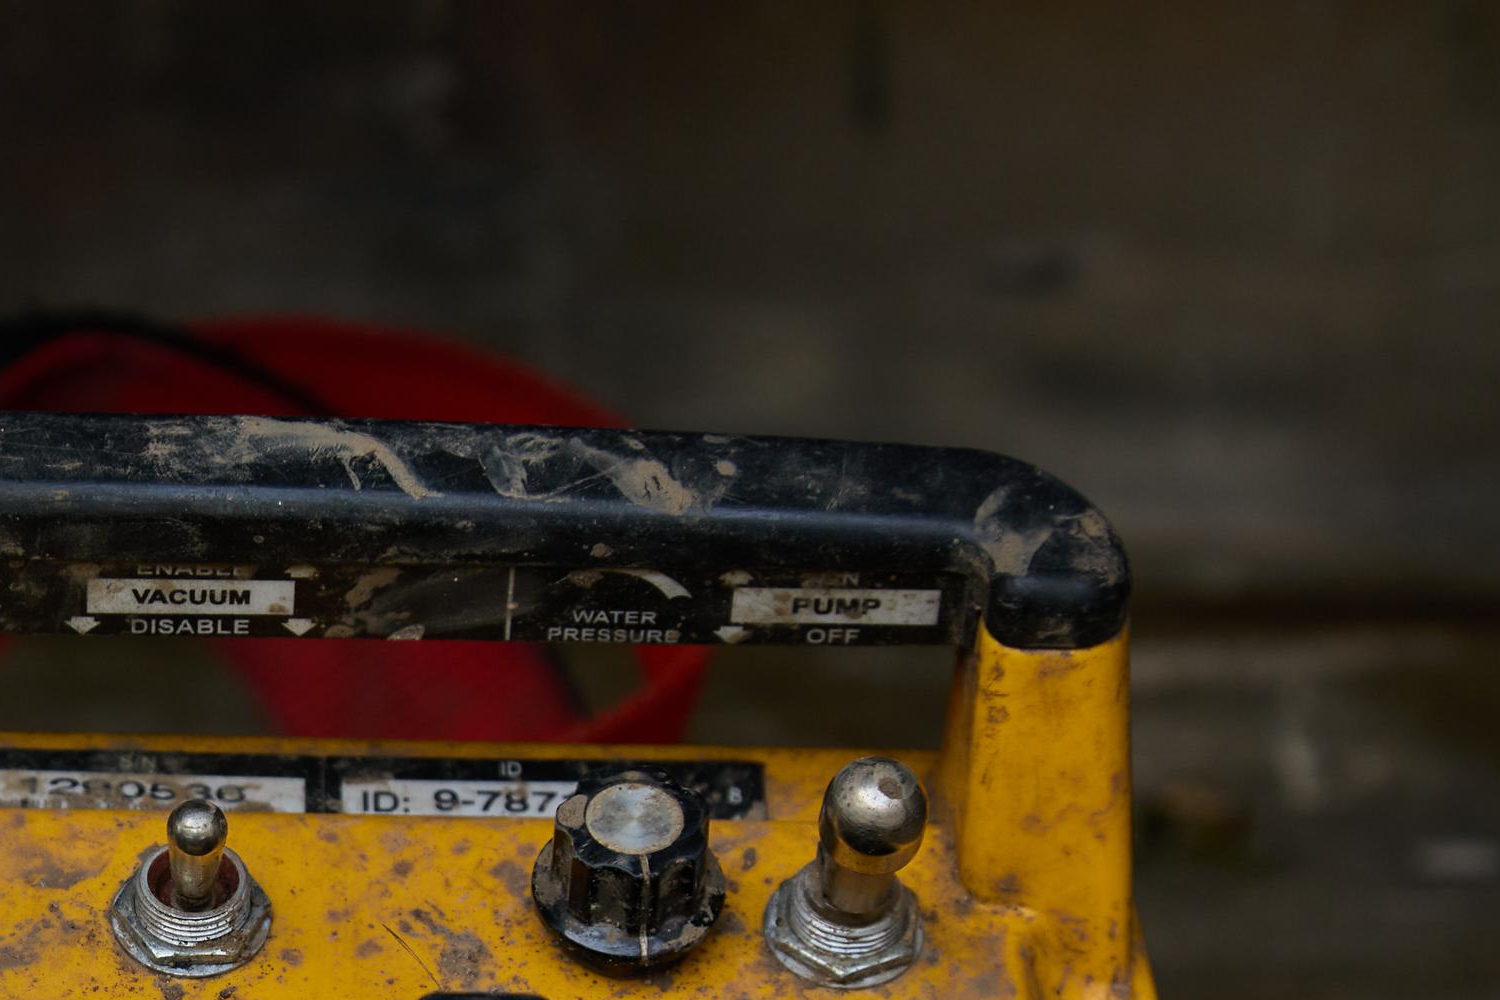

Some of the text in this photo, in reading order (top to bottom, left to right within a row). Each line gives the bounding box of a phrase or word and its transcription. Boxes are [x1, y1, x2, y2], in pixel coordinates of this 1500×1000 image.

[131, 588, 252, 606] VACUUM
[792, 597, 881, 616] PUMP
[572, 608, 658, 625] WATER
[130, 618, 251, 635] DISABLE
[547, 626, 681, 644] PRESSURE
[805, 628, 861, 645] OFF
[501, 760, 523, 778] ID
[362, 788, 573, 813] ID: 9-787
